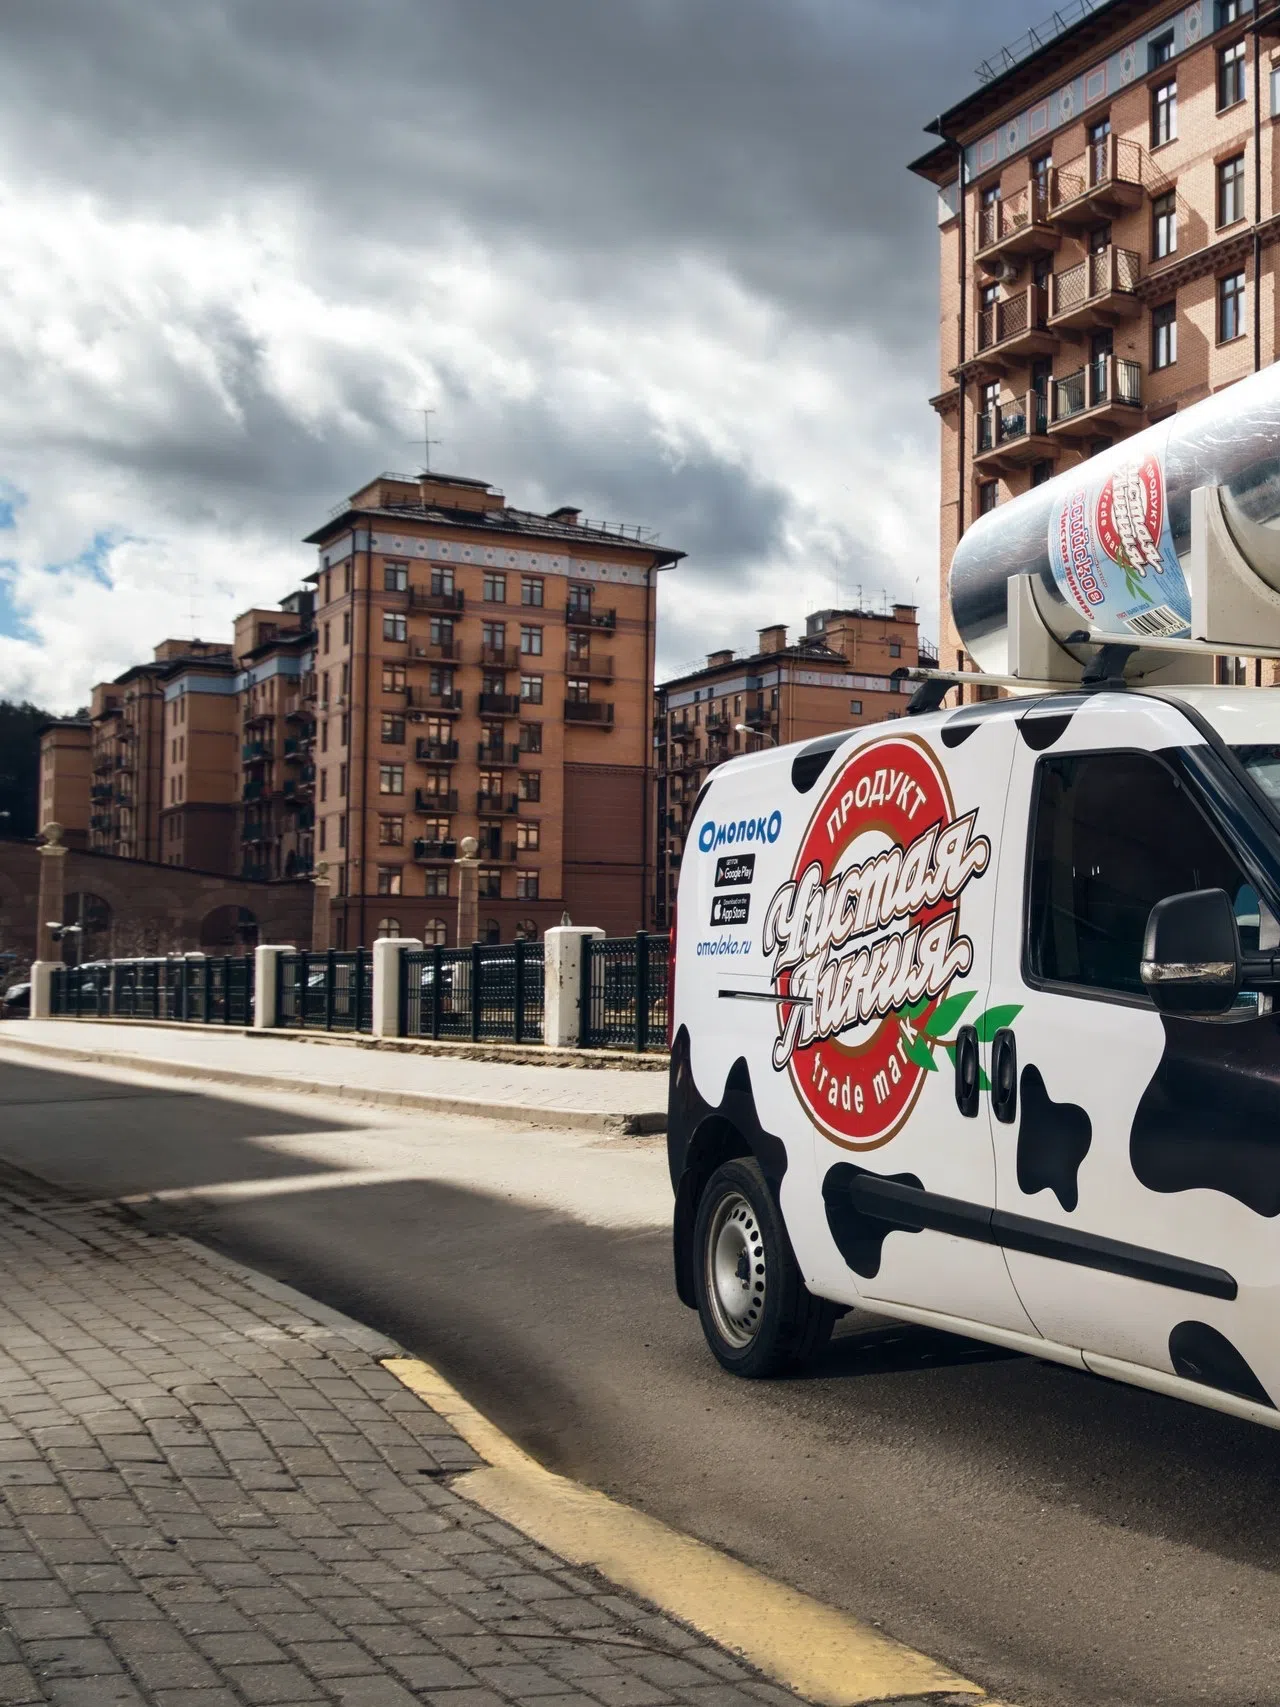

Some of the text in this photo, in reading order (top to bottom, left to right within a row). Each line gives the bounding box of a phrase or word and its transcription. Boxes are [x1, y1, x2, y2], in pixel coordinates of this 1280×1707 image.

[1145, 463, 1158, 530] ПРОДУКТ
[825, 769, 926, 844] ПРОДУКТ
[724, 865, 753, 881] Google Play
[763, 807, 991, 978] Чистая
[696, 934, 752, 957] omoloko.ru
[721, 906, 747, 922] App Store
[773, 914, 974, 1071] Линия
[813, 1015, 921, 1115] trade mark
